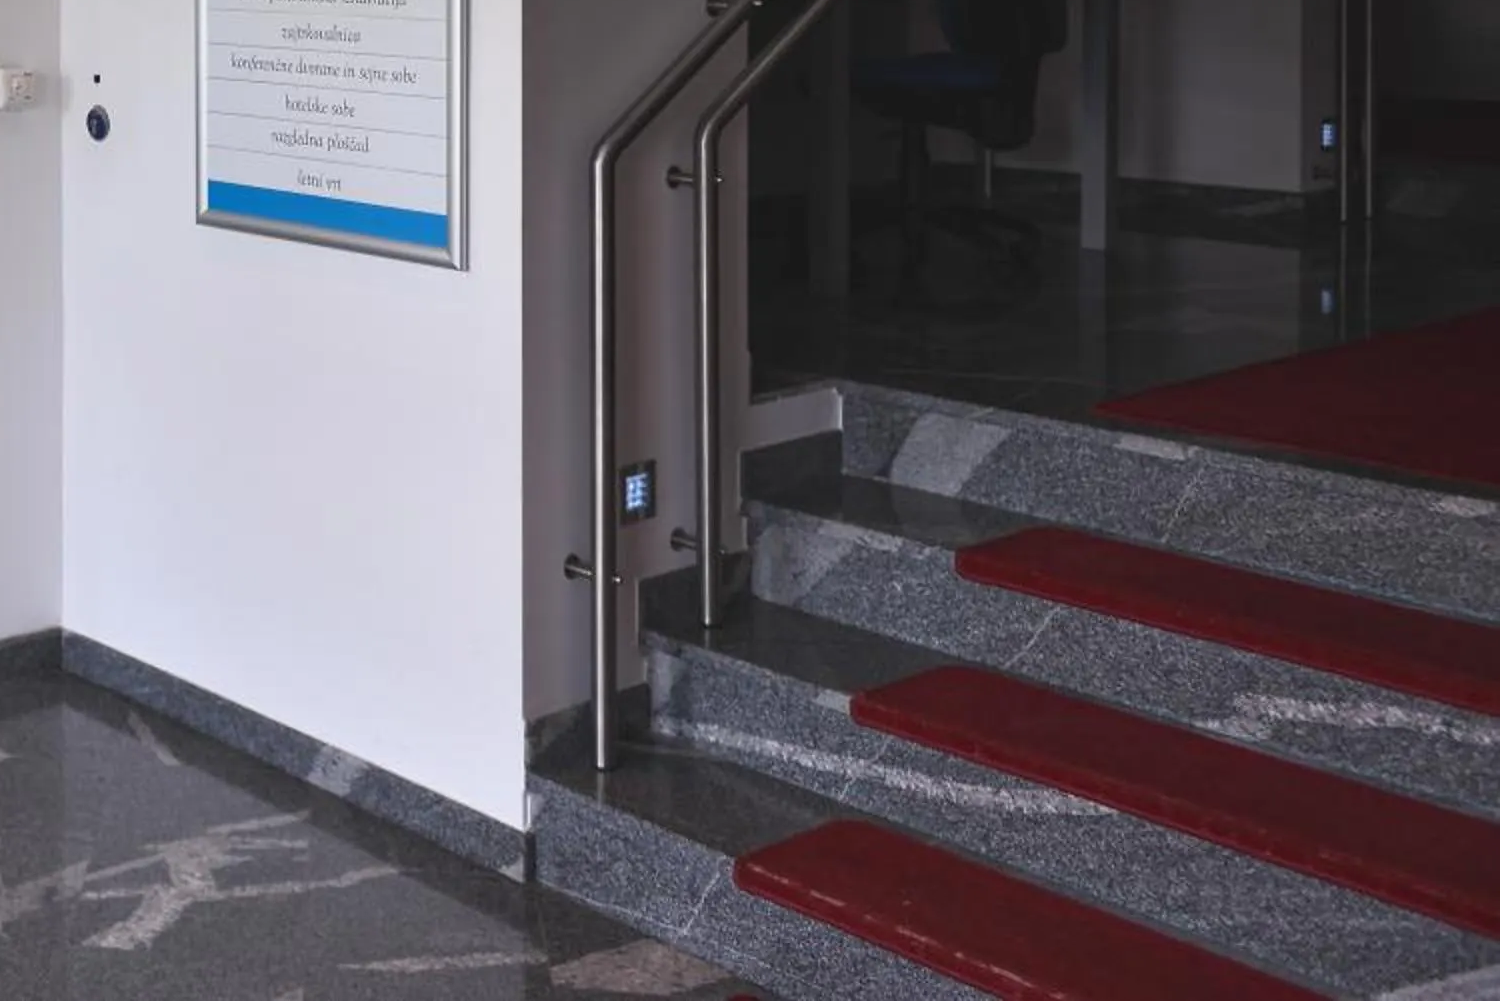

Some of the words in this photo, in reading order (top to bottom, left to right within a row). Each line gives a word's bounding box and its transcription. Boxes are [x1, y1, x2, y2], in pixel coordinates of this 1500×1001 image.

[343, 64, 356, 79] in
[390, 65, 418, 85] sobe
[285, 93, 329, 115] hotelske
[331, 97, 357, 118] sobe
[297, 168, 323, 189] letni
[325, 178, 342, 192] vrt
